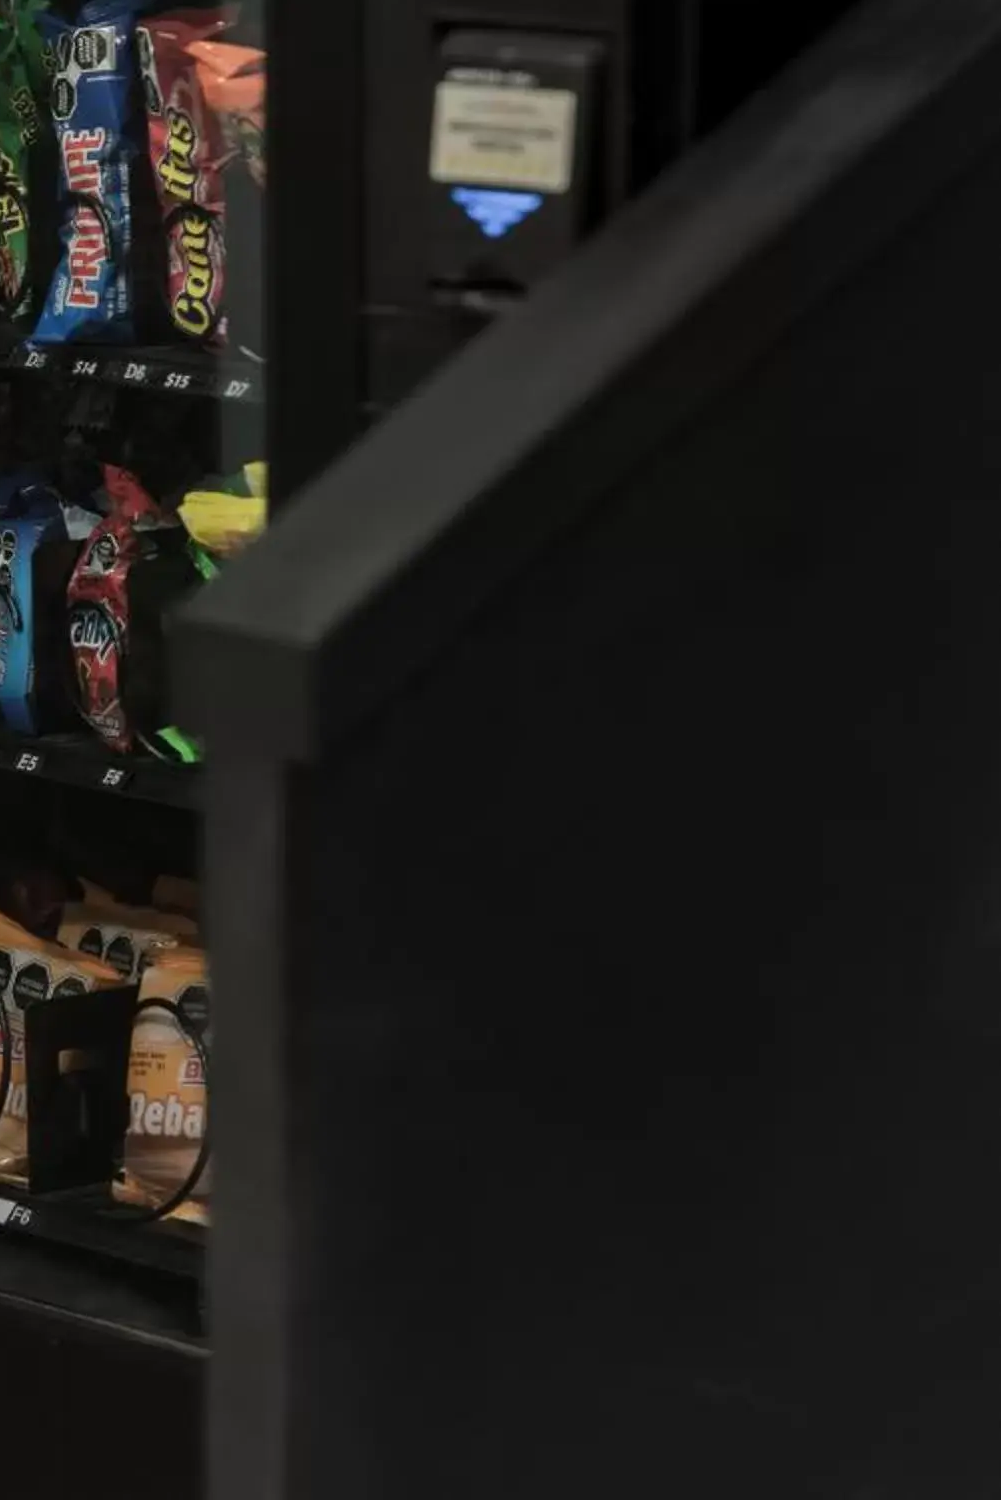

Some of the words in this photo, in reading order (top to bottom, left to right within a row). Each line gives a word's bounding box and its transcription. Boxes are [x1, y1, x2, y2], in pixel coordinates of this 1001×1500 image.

[158, 113, 210, 335] Caneitas
[72, 359, 98, 376] $14
[164, 371, 191, 389] $15
[223, 379, 251, 399] D7
[15, 752, 40, 772] E5
[10, 1205, 32, 1226] F6
